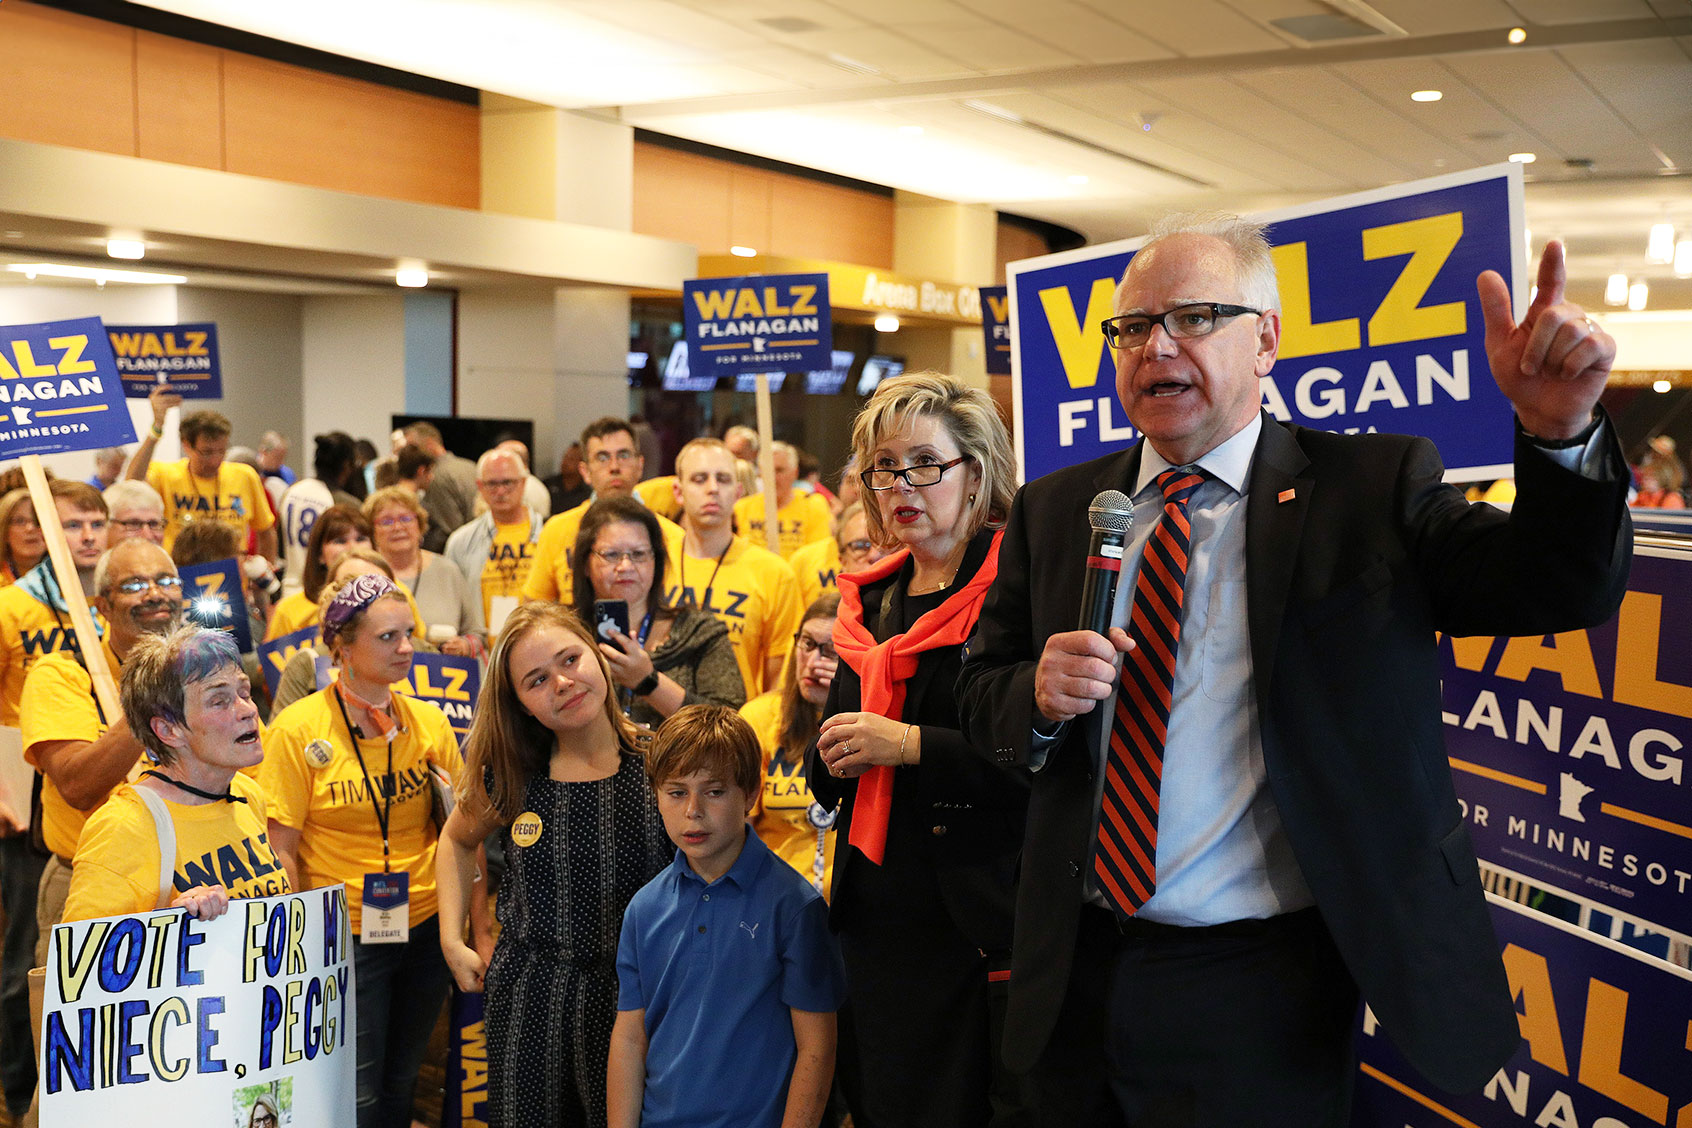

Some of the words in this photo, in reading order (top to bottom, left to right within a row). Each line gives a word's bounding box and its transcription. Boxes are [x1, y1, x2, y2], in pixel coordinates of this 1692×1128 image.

[693, 285, 818, 320] WALZ
[863, 272, 918, 310] Arena
[920, 281, 955, 315] Box
[1038, 211, 1468, 389] WLZ
[109, 331, 209, 357] WALZ
[698, 317, 819, 338] FLANAGAN
[116, 357, 211, 371] FLANAGAN
[1058, 348, 1471, 447] FLAGAN
[287, 503, 317, 547] 18
[513, 823, 540, 835] PEGGY
[55, 911, 207, 1004] VOTE
[242, 897, 307, 983] FOR
[323, 889, 348, 967] MY
[369, 929, 401, 938] DELEGATE
[46, 996, 247, 1094] NIECE,
[259, 966, 349, 1072] PEGGY
